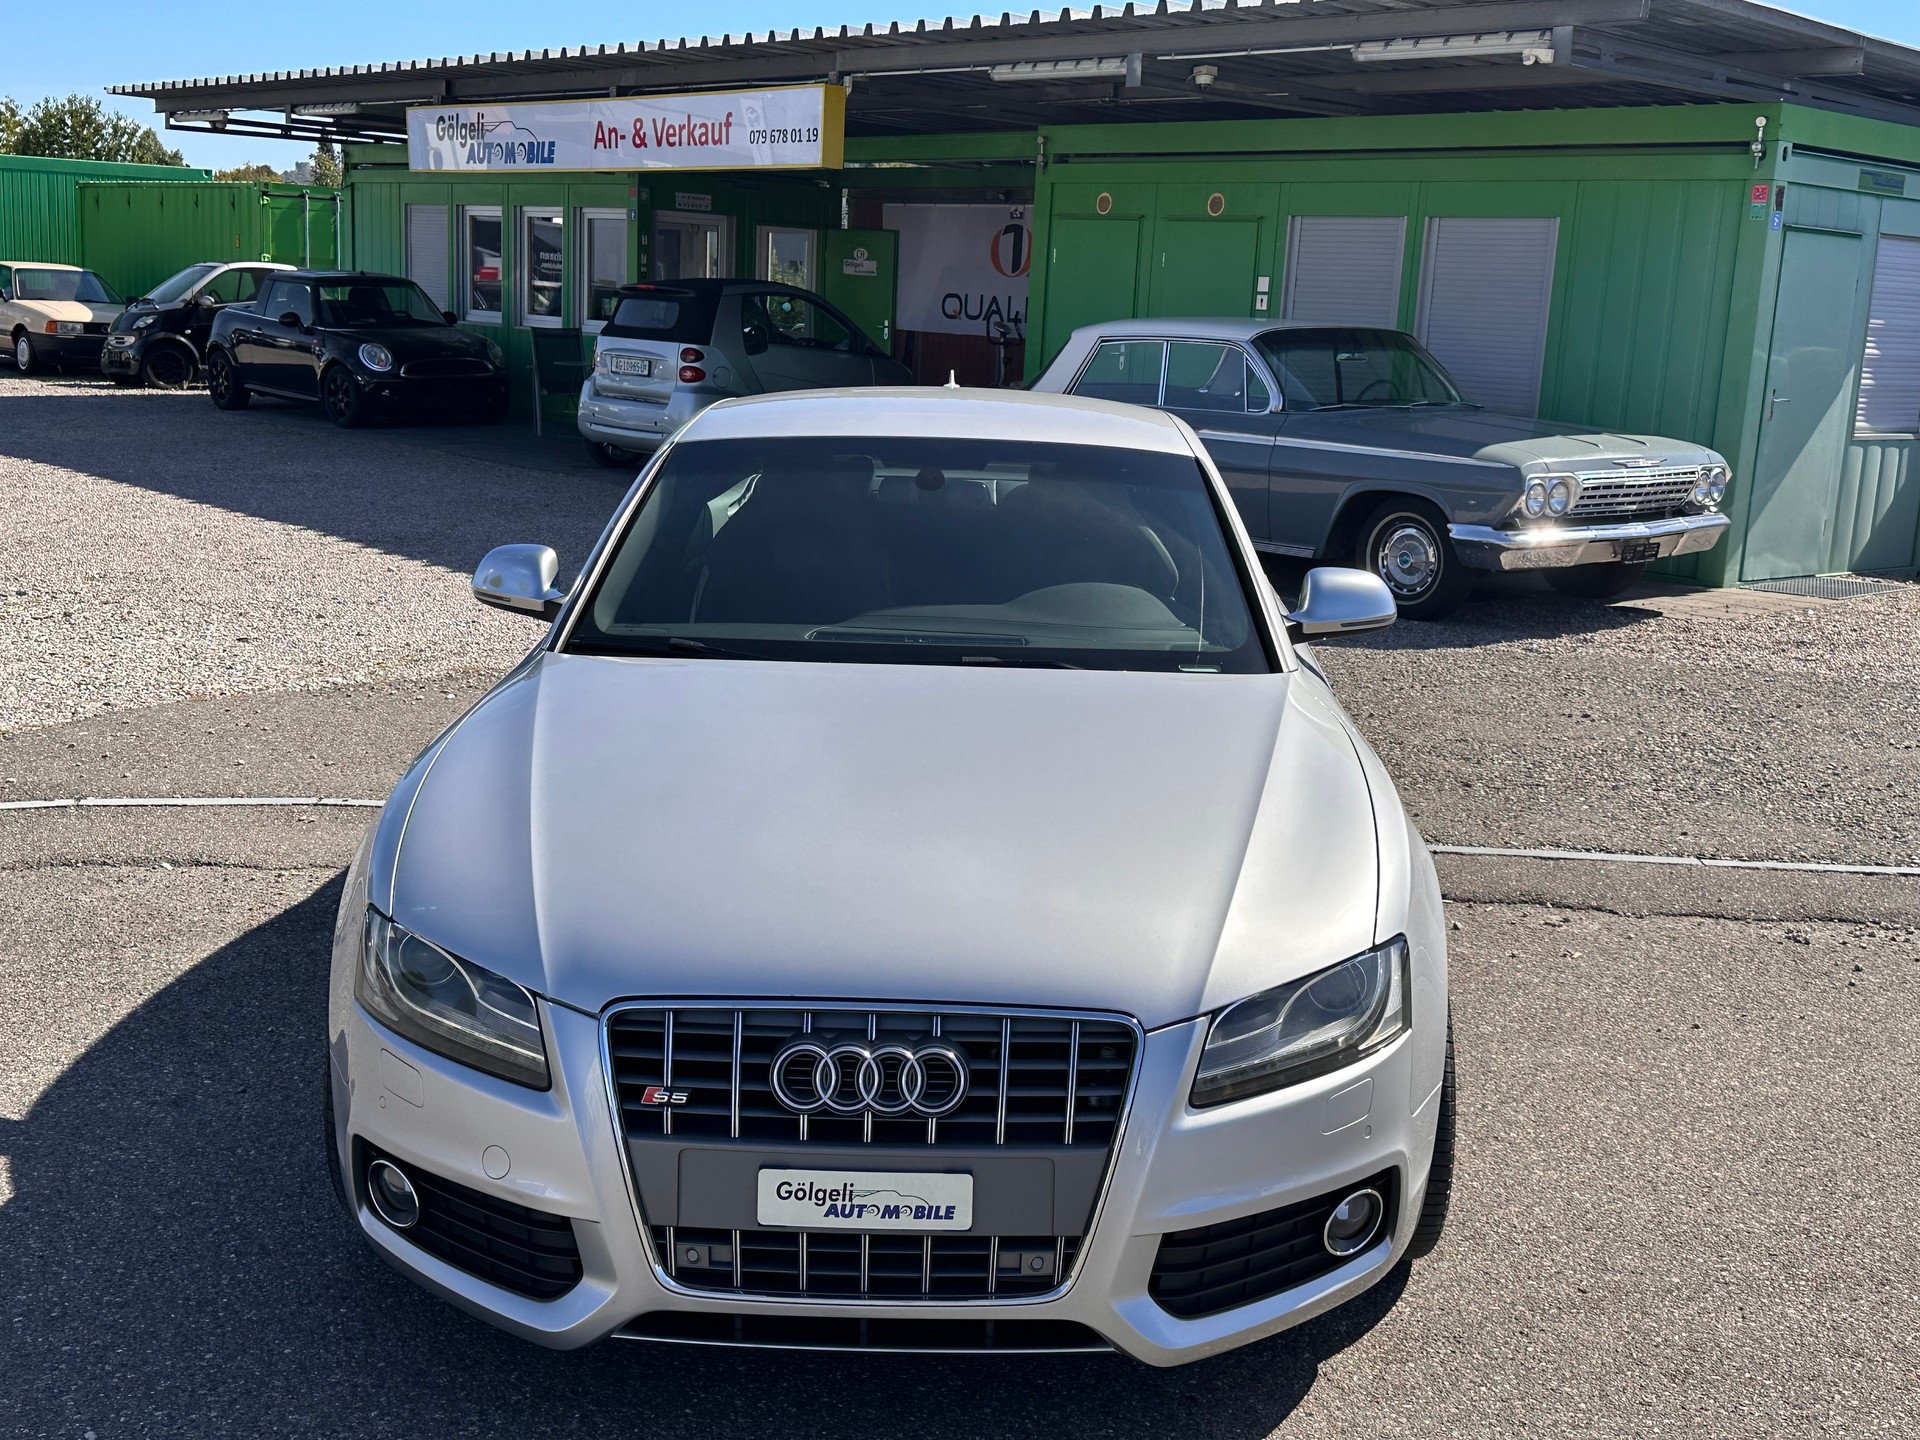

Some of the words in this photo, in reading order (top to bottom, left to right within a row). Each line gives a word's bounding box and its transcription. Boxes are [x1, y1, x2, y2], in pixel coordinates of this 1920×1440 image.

[436, 112, 485, 148] Gölgeli
[594, 120, 626, 150] An-
[632, 117, 648, 149] &
[652, 112, 733, 148] Verkauf
[749, 129, 768, 145] 079
[769, 128, 788, 144] 678
[790, 127, 803, 144] 01
[806, 127, 819, 143] 19
[652, 1091, 689, 1104] S5
[776, 1181, 855, 1206] Gölgeli
